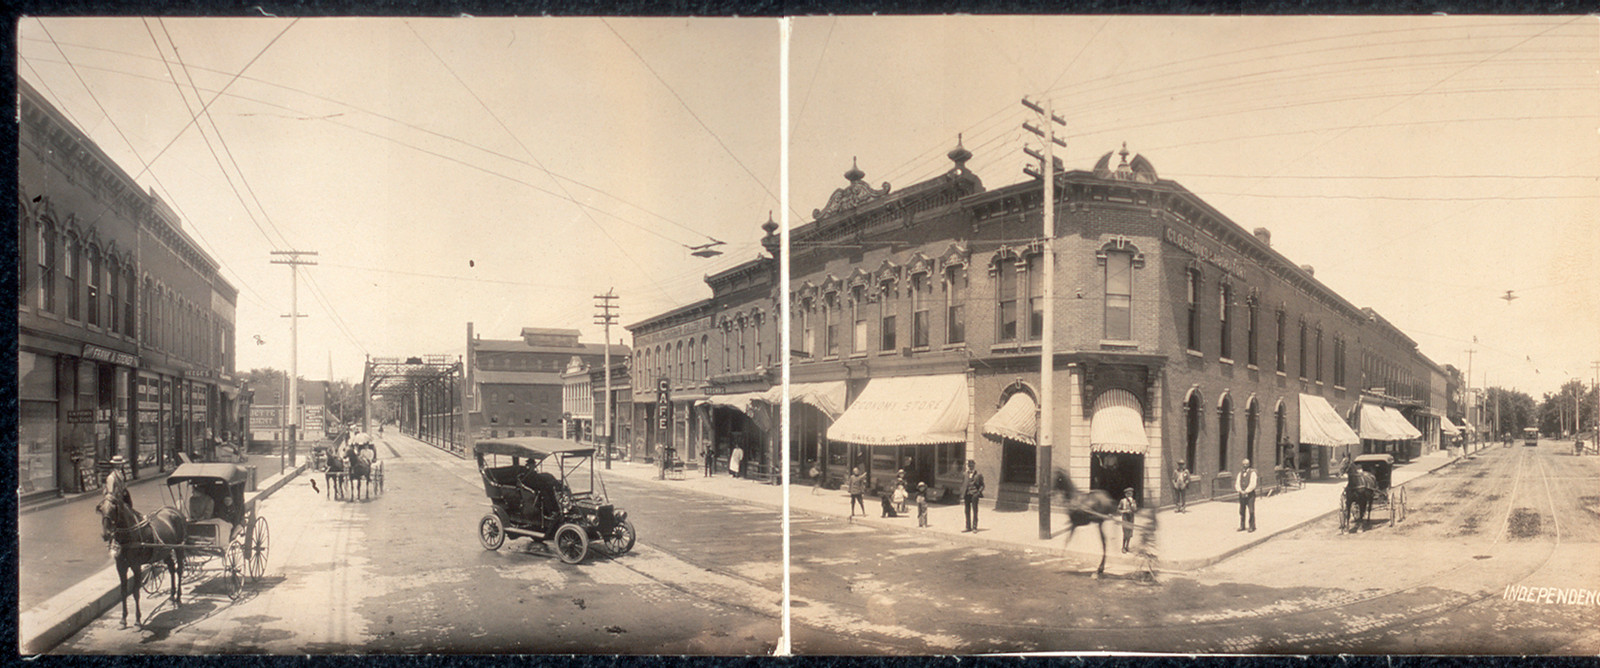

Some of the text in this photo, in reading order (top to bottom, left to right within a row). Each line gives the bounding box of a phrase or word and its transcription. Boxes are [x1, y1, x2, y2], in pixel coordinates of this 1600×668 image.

[658, 381, 668, 429] CAFE
[851, 400, 944, 412] ECONOMY STORE
